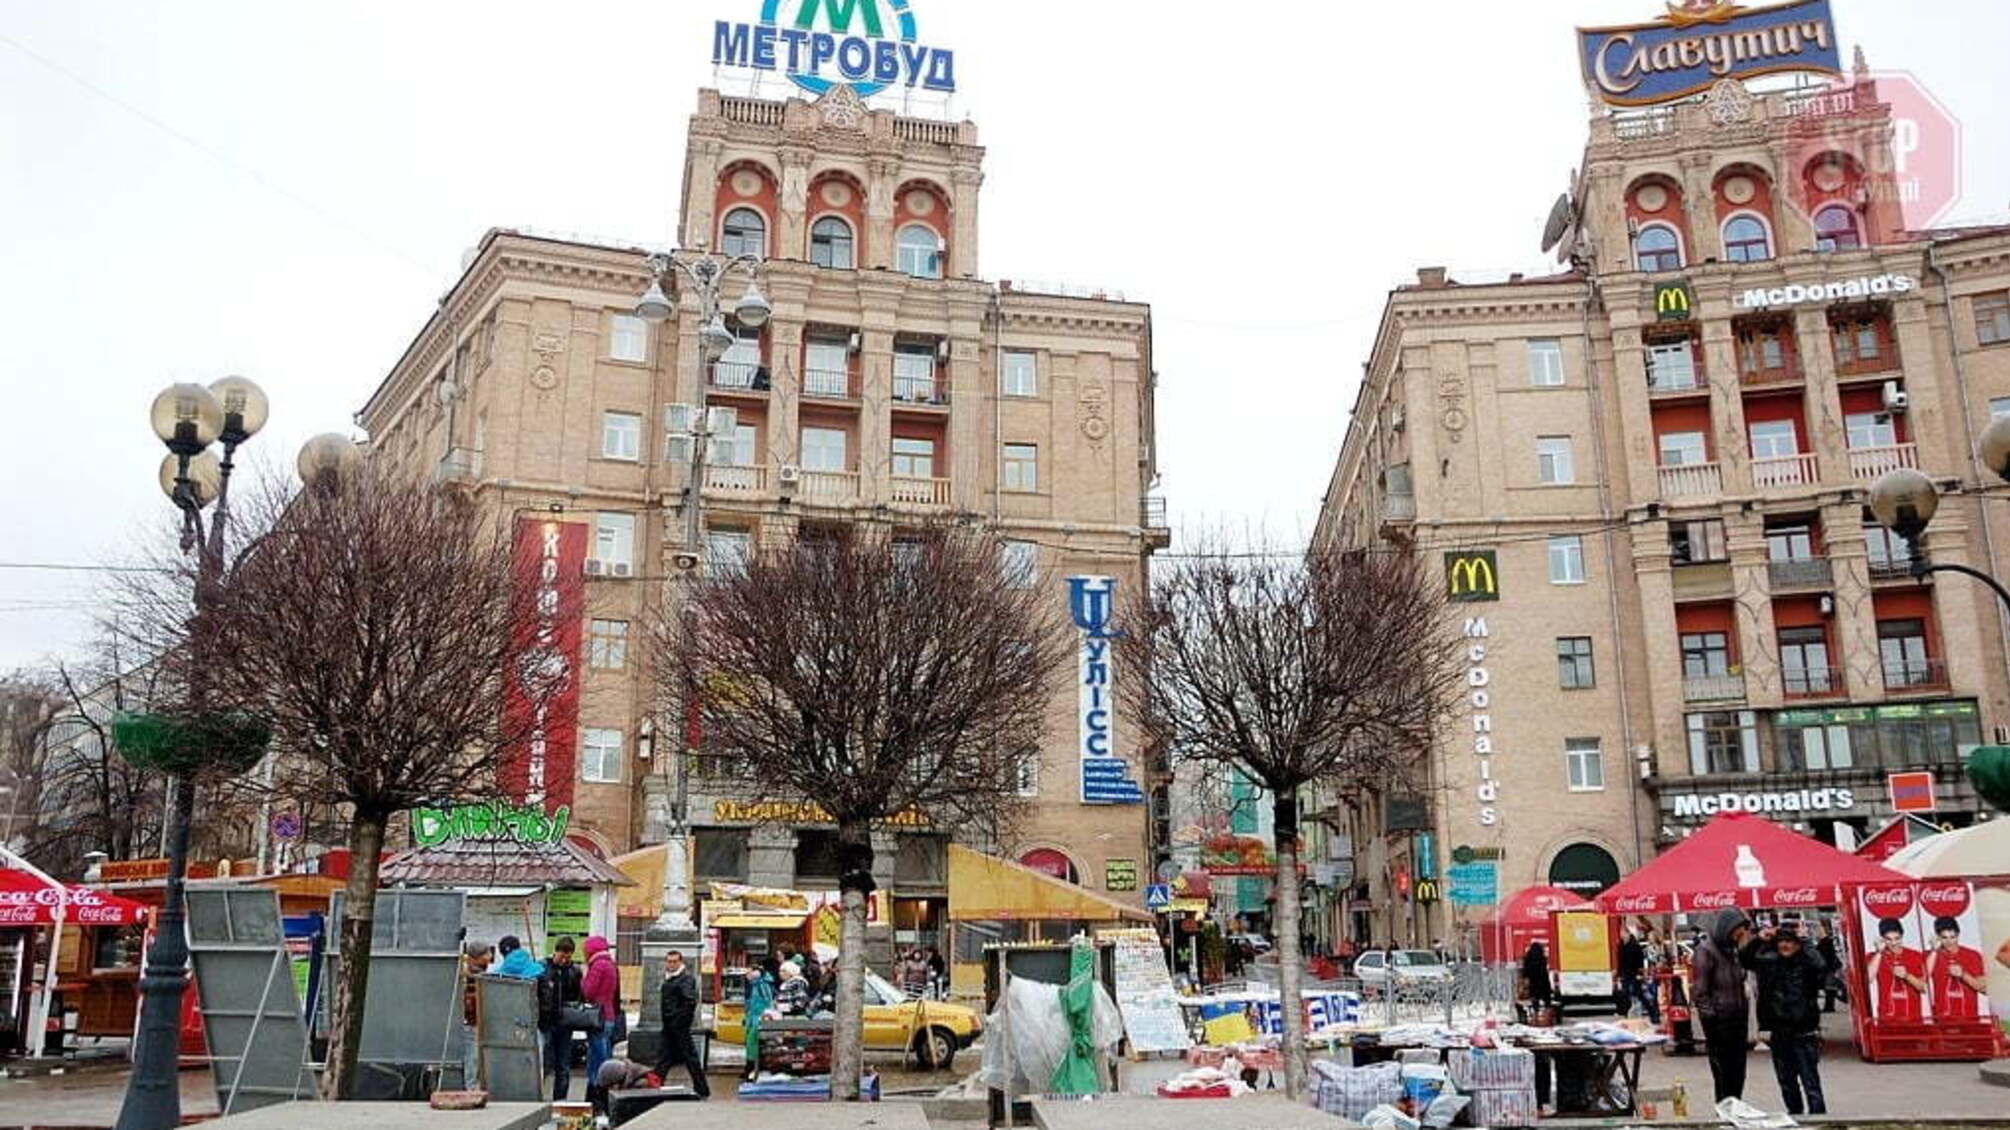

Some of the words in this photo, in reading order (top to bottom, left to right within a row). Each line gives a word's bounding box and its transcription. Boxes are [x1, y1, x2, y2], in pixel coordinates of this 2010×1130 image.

[712, 20, 955, 92] МЕТРОБУД
[1595, 18, 1827, 93] Славутич
[1743, 275, 1910, 307] McDonald's
[1464, 617, 1500, 825] McDonald's
[1674, 789, 1853, 816] McDonald's
